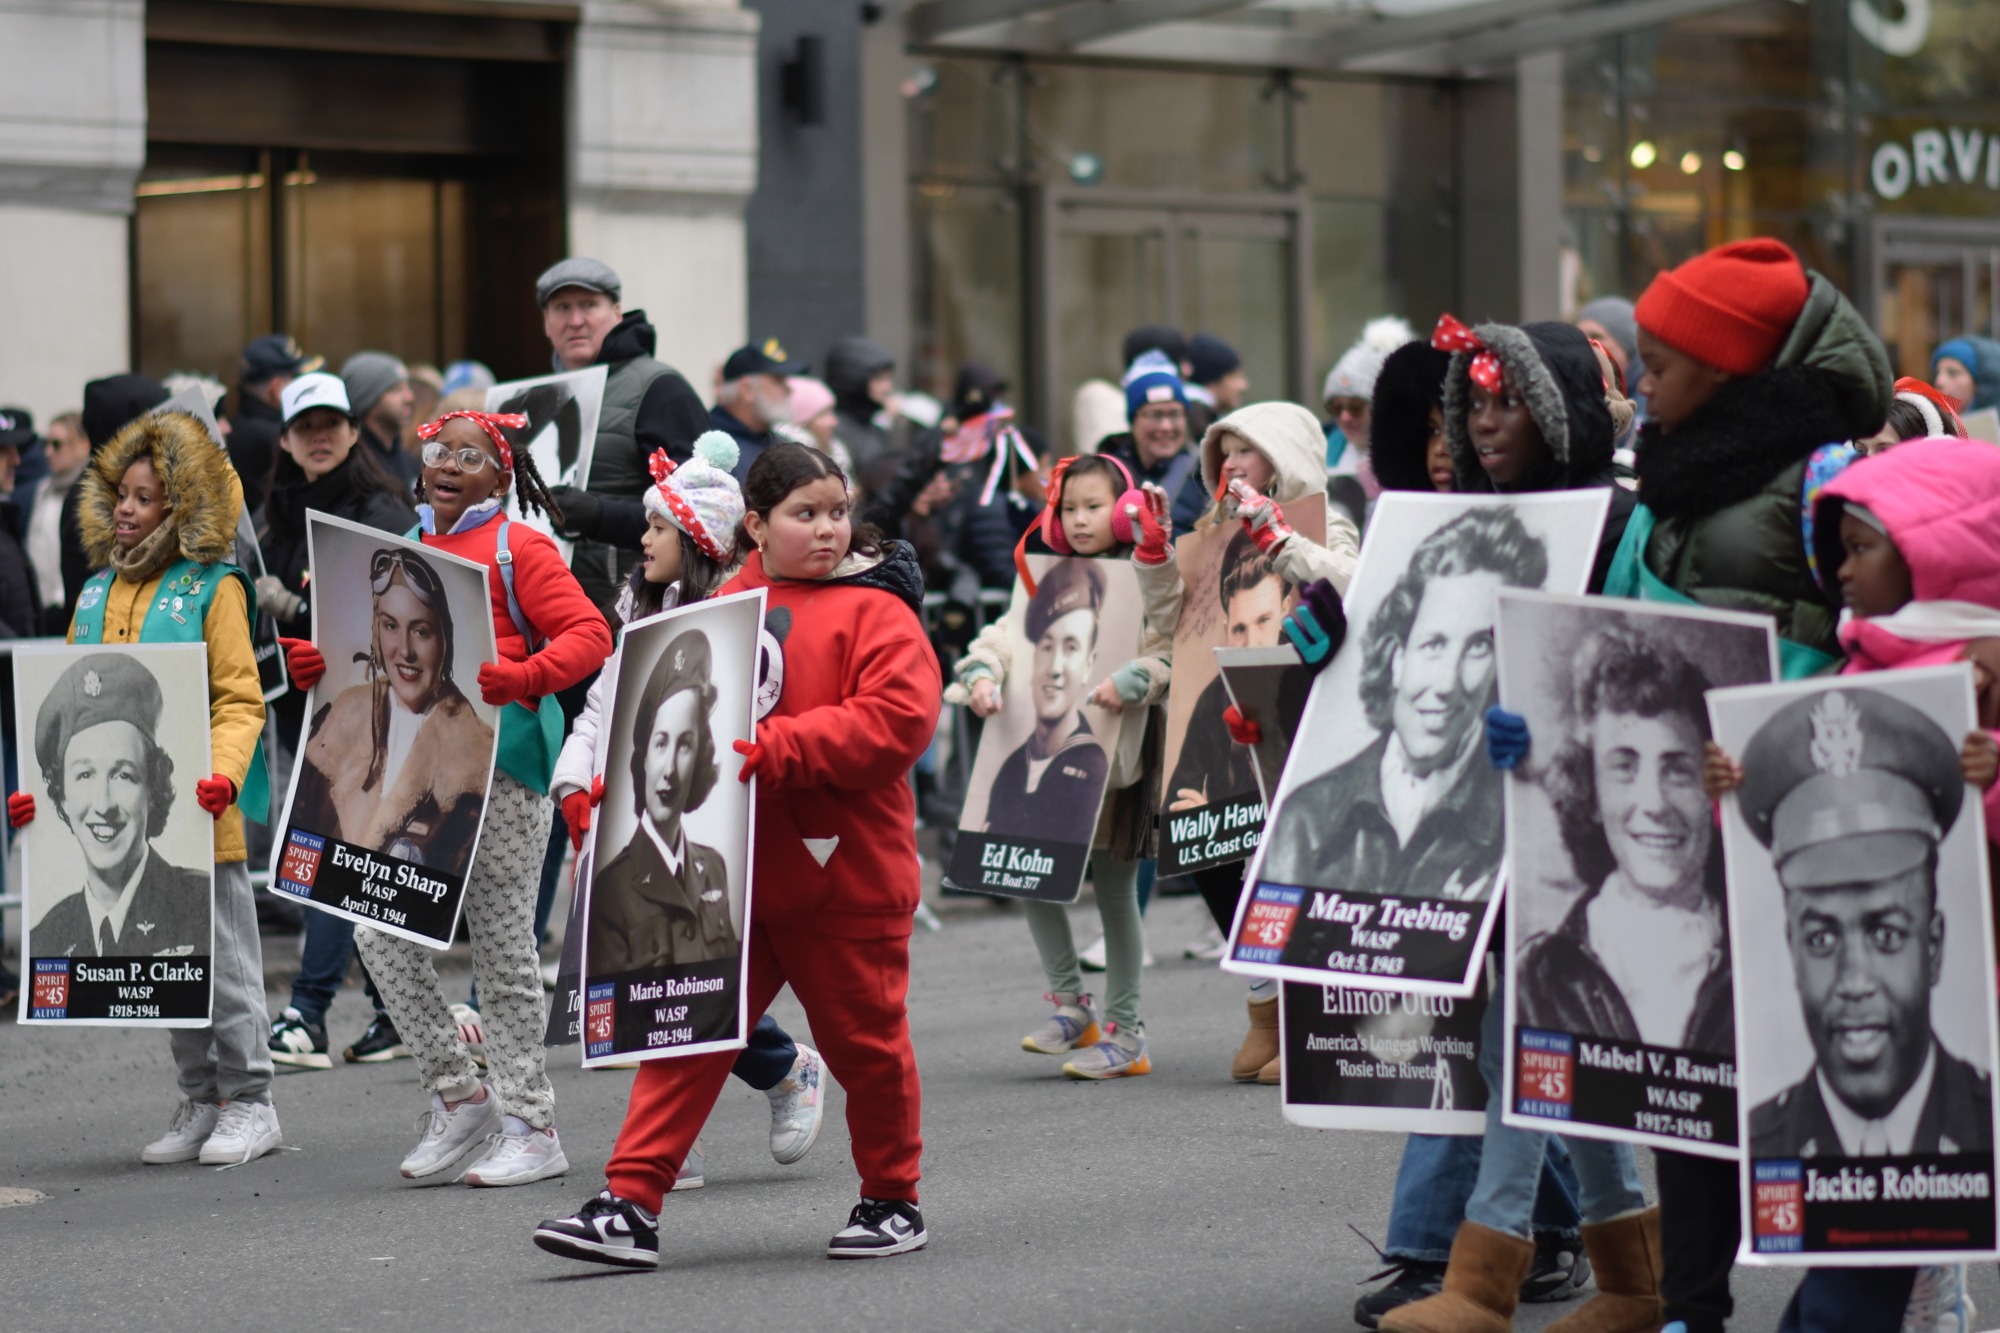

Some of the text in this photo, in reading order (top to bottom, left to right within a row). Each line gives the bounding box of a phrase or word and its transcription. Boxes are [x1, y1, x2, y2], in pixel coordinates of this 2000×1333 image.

[1871, 125, 2000, 199] ORVI
[1170, 810, 1220, 843] Wally
[292, 833, 322, 848] KEEP THE
[1178, 845, 1202, 865] U.S.
[1205, 836, 1241, 858] Coast
[288, 846, 318, 863] SPIRIT
[981, 842, 1054, 874] Ed Kohn
[331, 843, 448, 903] Evelyn Sharp
[982, 870, 1040, 890] P.T. Boat 377
[281, 880, 310, 896] ALIVE!
[361, 880, 398, 902] WASP
[340, 895, 407, 926] April 3, 1944
[1307, 891, 1471, 941] Mary Trebing
[1350, 926, 1400, 950] WASP
[36, 963, 67, 971] KEEP THE
[1327, 951, 1354, 969] Oct
[36, 975, 66, 986] SPIRIT
[76, 962, 204, 982] Susan P. Clarke
[118, 986, 154, 1000] WASP
[589, 987, 613, 999] KEEP THE
[629, 976, 724, 1002] Marie Robinson
[567, 989, 580, 1013] To
[589, 1002, 611, 1017] SPIRIT
[1322, 985, 1396, 1015] Elinor
[34, 1008, 65, 1018] ALIVE!
[108, 1004, 161, 1018] 1918-1944
[655, 1006, 688, 1024] WASP
[647, 1027, 693, 1046] 1924-1944
[1306, 1033, 1475, 1060] America's Longest Working
[590, 1041, 612, 1055] ALIVE!
[1336, 1059, 1442, 1080] 'Rosie the Rivete
[1579, 1042, 1643, 1073] Mabel
[1648, 1052, 1671, 1077] V.
[1646, 1086, 1702, 1112] WASP
[1634, 1111, 1713, 1140] 1917-1943
[1804, 1164, 1990, 1201] Jackie Robinson
